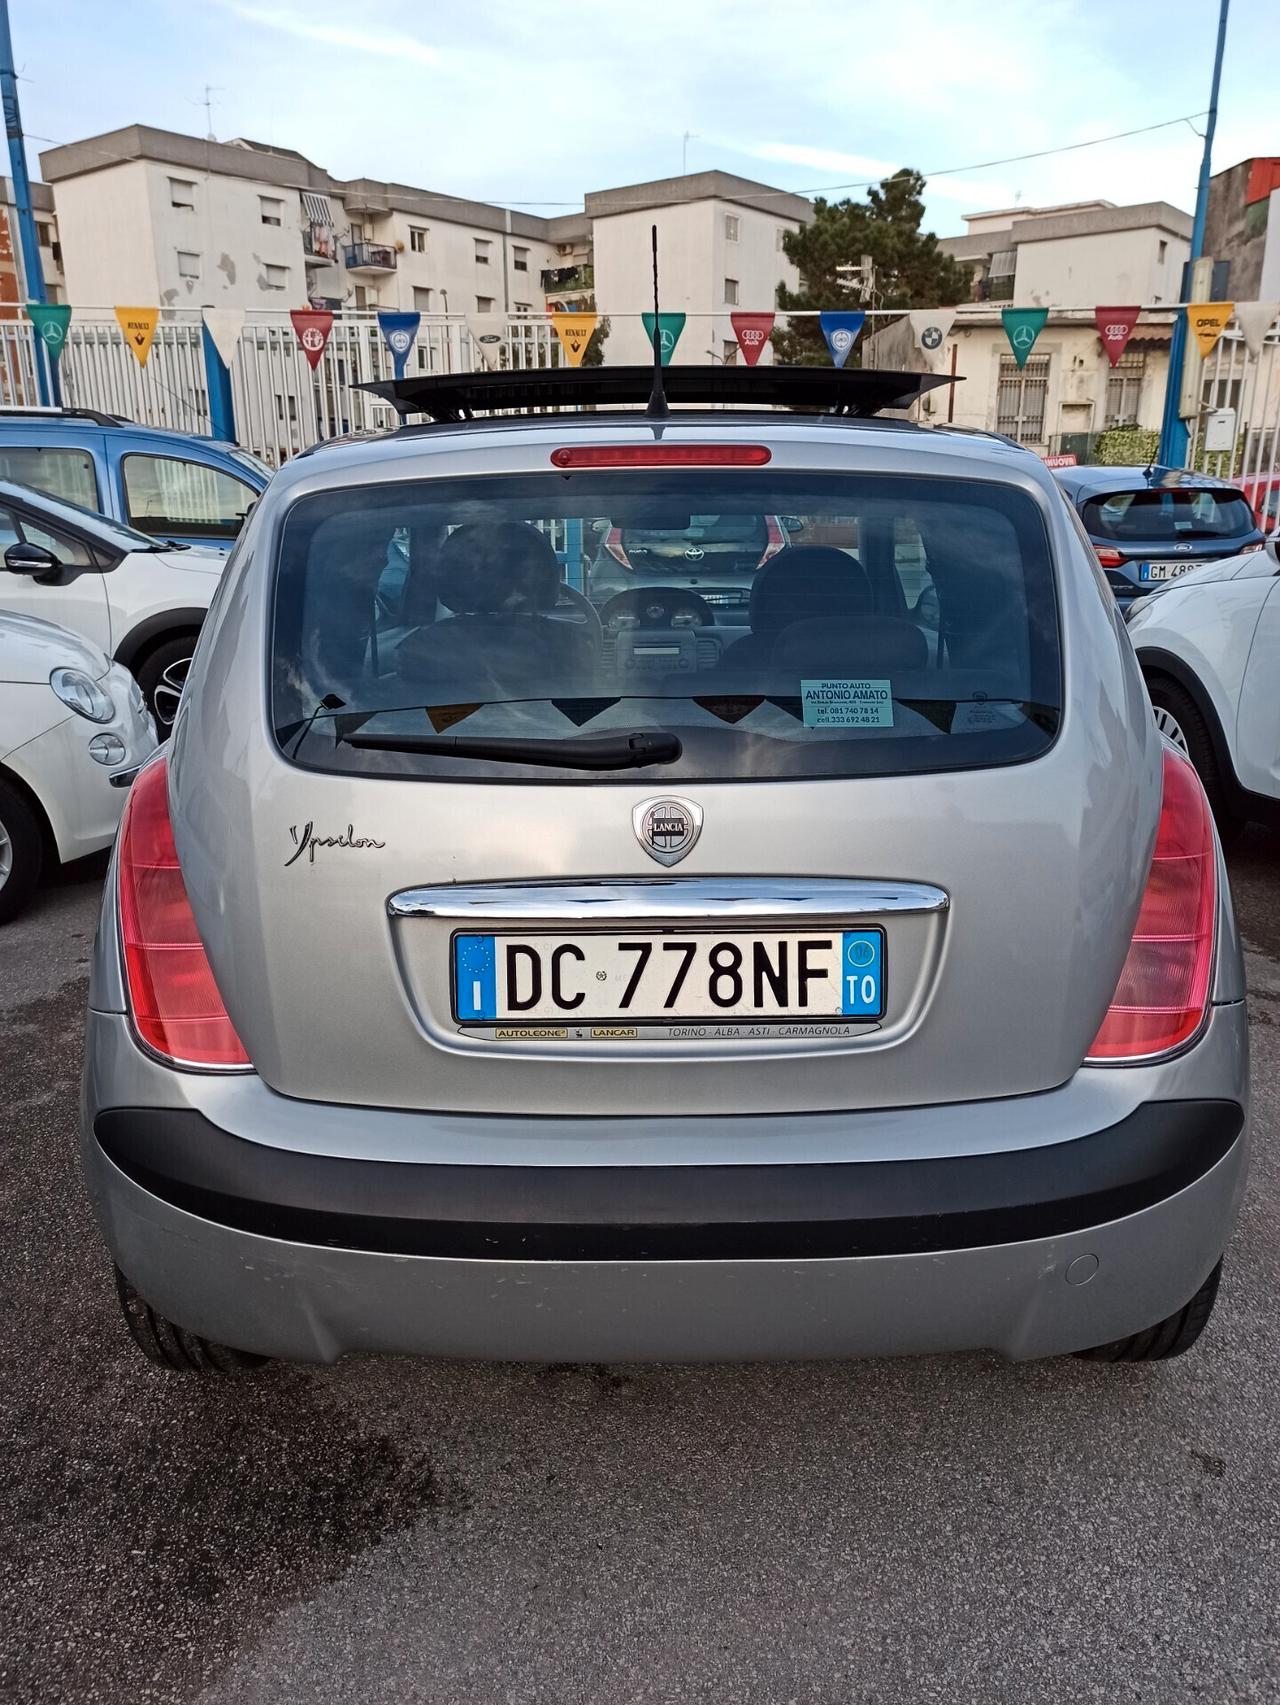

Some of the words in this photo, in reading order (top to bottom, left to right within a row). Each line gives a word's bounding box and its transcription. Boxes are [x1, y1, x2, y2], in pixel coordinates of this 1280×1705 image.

[127, 322, 150, 330] RENAULT
[1196, 319, 1221, 327] OPEL
[565, 329, 587, 337] RENAULT
[1151, 565, 1166, 578] GM
[806, 690, 851, 700] ANTONIO
[852, 690, 888, 700] AMATO
[817, 707, 829, 715] tel.
[830, 707, 843, 715] 081
[845, 707, 858, 715] 740
[859, 707, 869, 715] 78
[870, 707, 879, 715] 14
[831, 716, 845, 724] 333
[653, 823, 684, 832] LANCIA
[284, 821, 386, 867] Ypsilon
[472, 980, 482, 1011] I
[506, 943, 586, 1011] DC
[618, 940, 832, 1009] 778NF
[846, 975, 876, 1005] TO
[593, 1029, 635, 1037] LANCAR
[668, 1027, 707, 1037] TORINO
[714, 1027, 740, 1036] ALBA
[748, 1026, 771, 1036] ASTI
[778, 1026, 850, 1036] CARMAGNOLA
